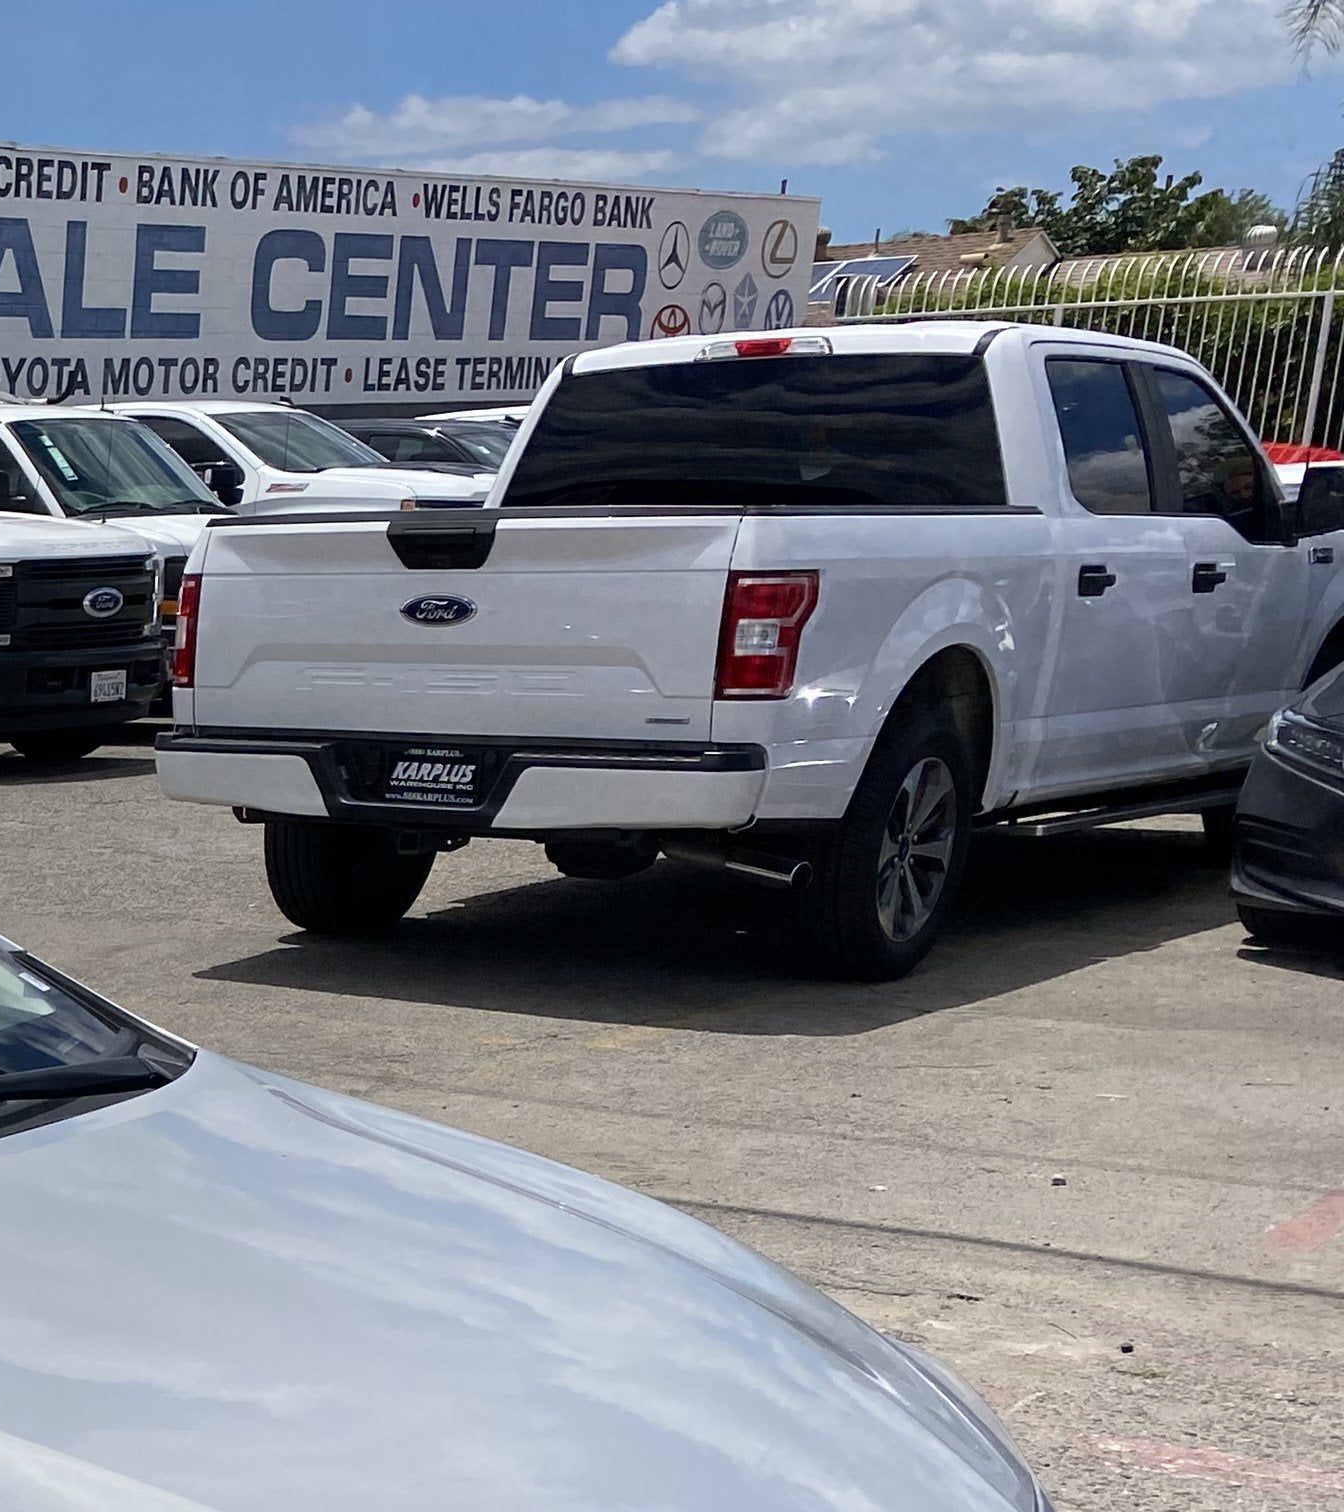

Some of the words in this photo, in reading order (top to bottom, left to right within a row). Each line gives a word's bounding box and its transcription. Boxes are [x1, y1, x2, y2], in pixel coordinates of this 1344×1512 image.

[136, 165, 220, 208] BANK
[230, 170, 267, 212] OF
[273, 174, 398, 218] AMERICA
[422, 183, 502, 222] WELLS
[510, 188, 587, 226] FARGO
[592, 194, 656, 230] BANK
[251, 229, 648, 342] CENTER
[102, 356, 219, 396] MOTOR
[232, 356, 338, 394] CREDIT
[362, 357, 447, 392] LEASE
[415, 599, 459, 620] Ford
[389, 780, 454, 790] WAREHOUSE
[391, 761, 476, 783] KARPLUS
